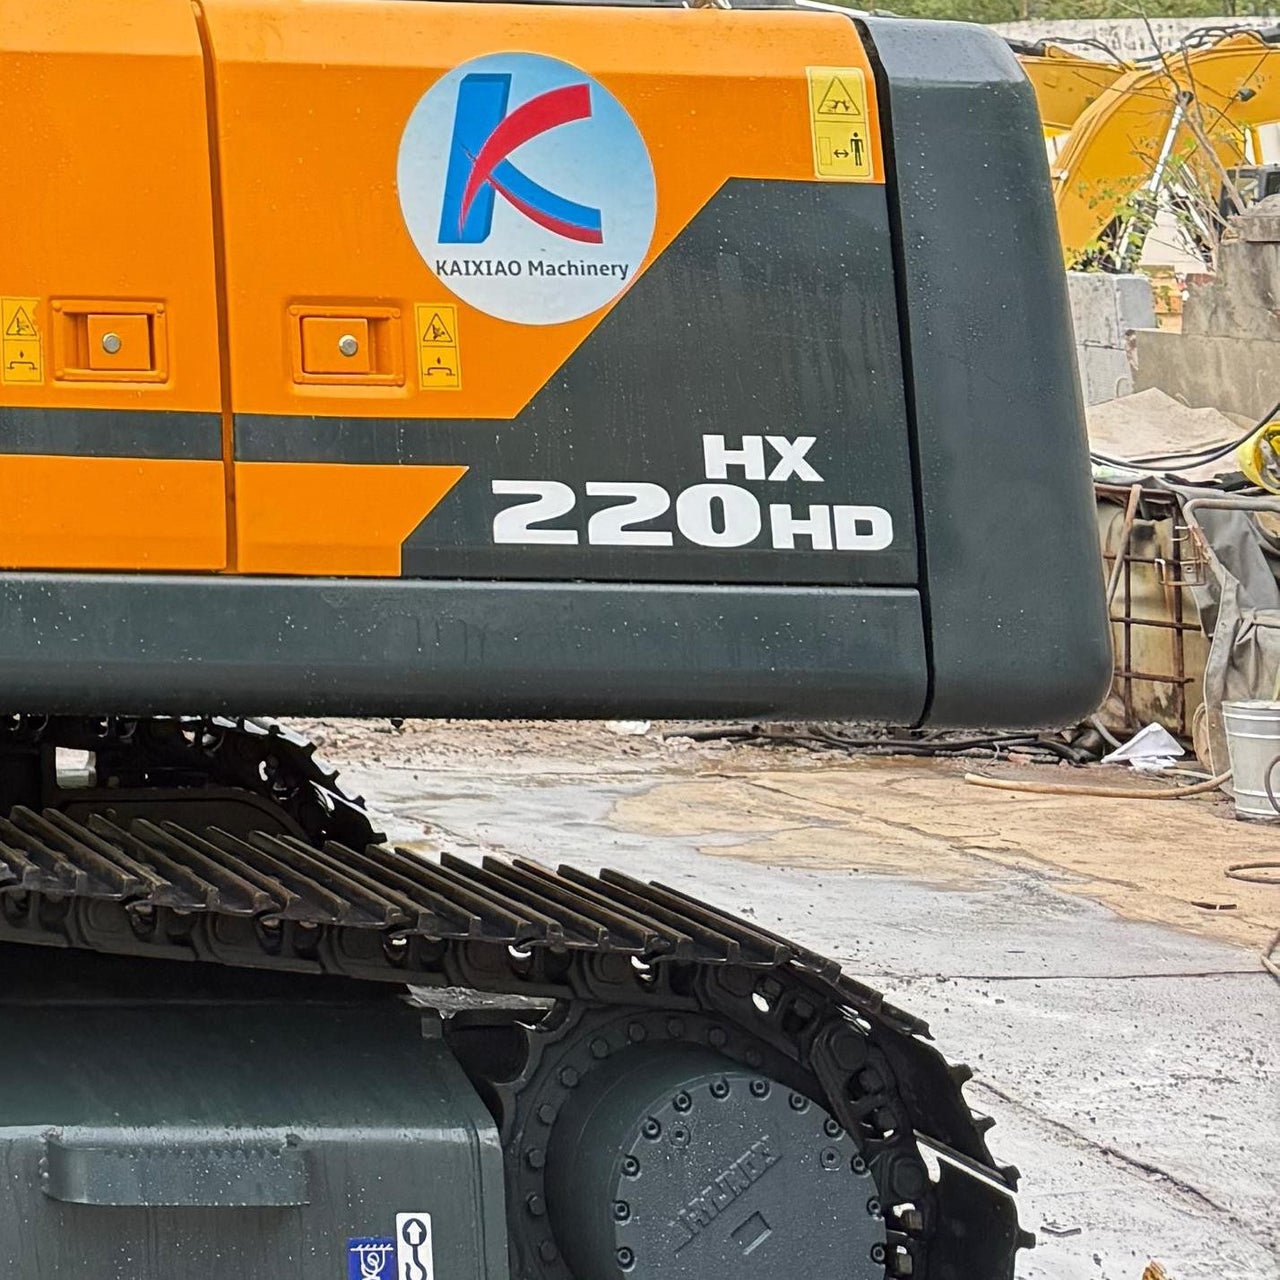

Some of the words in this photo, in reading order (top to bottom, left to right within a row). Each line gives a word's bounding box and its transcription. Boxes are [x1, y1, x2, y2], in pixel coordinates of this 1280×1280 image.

[435, 259, 522, 277] KAIXIAO
[527, 259, 629, 281] Machinery
[702, 434, 825, 482] HX
